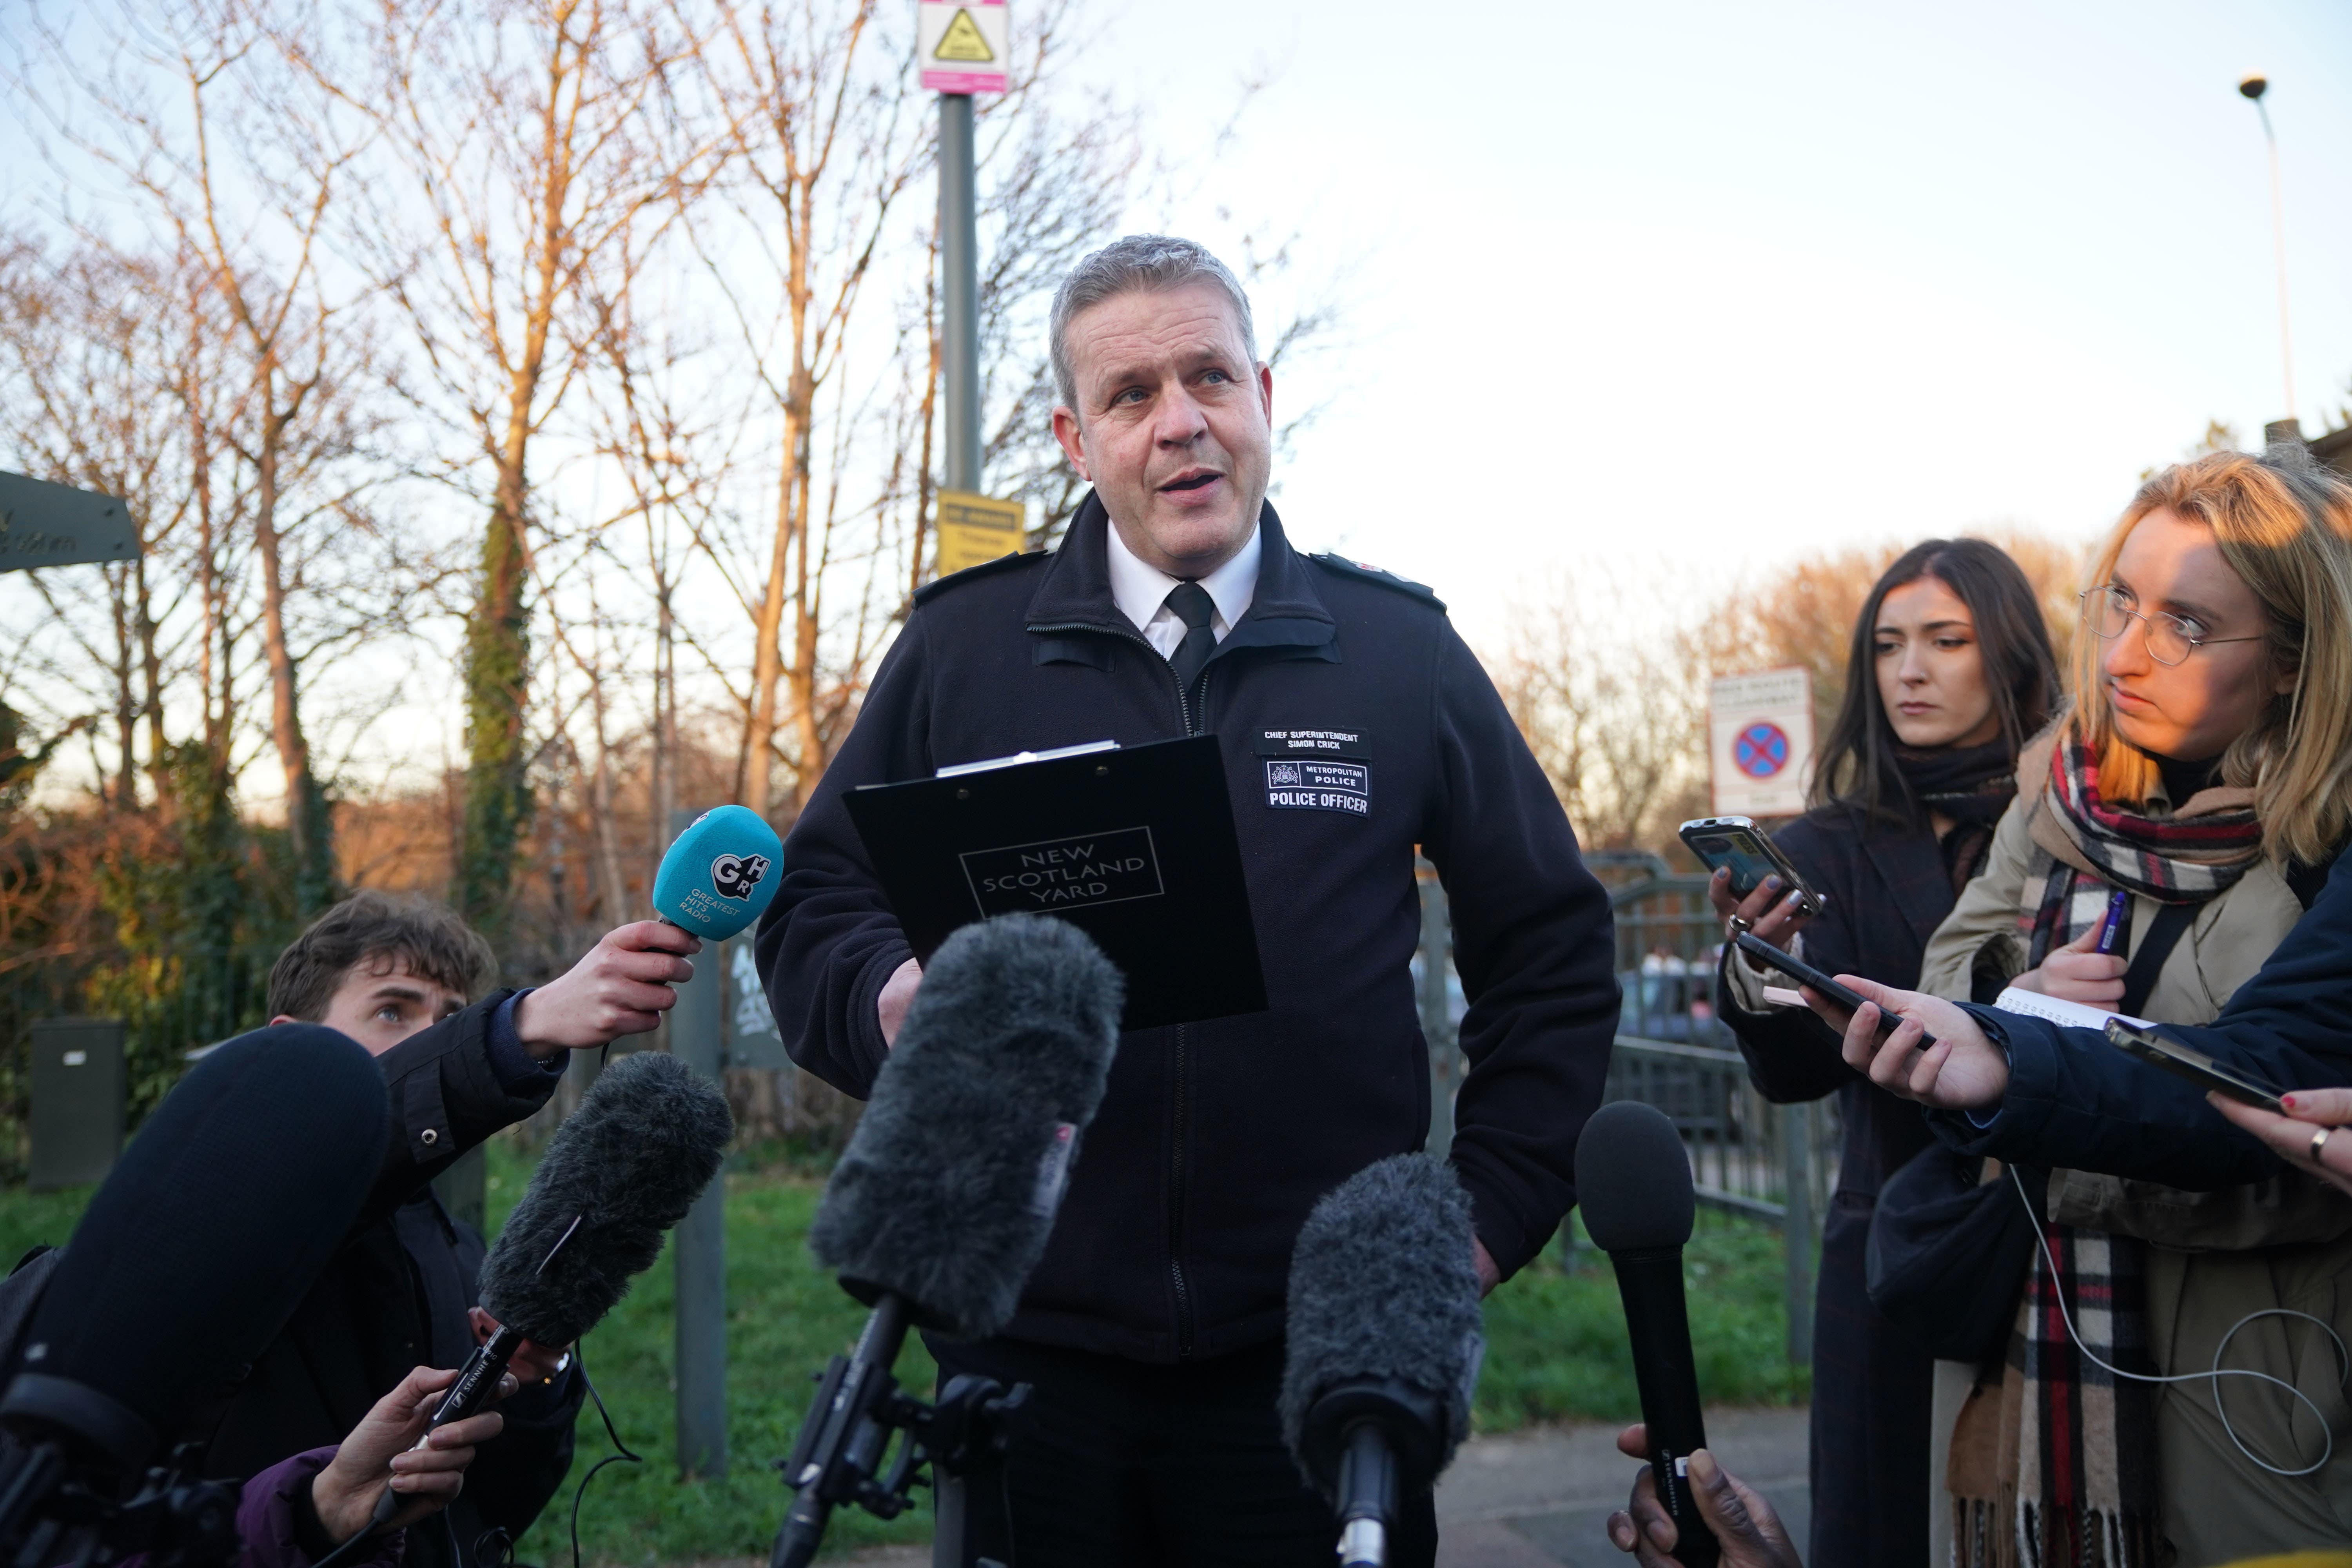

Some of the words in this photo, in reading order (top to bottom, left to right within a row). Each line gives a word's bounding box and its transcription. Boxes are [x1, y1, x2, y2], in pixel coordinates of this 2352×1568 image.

[1290, 731, 1358, 742] SUPERINTENDENT
[1317, 740, 1340, 750] CRICK
[1306, 766, 1362, 778] METROPOLITAN
[1315, 776, 1356, 786] POLICE
[1269, 792, 1316, 806] POLICE
[1320, 794, 1367, 813] OFFICER
[1021, 844, 1094, 867] NEW
[983, 858, 1145, 892] SCOTLAND
[1029, 882, 1107, 902] YARD
[679, 902, 711, 922] RADIO
[685, 895, 709, 912] HITS
[691, 889, 740, 916] GREATEST
[464, 1359, 490, 1392] SENNHE
[1665, 1462, 1679, 1516] SENNHEISER
